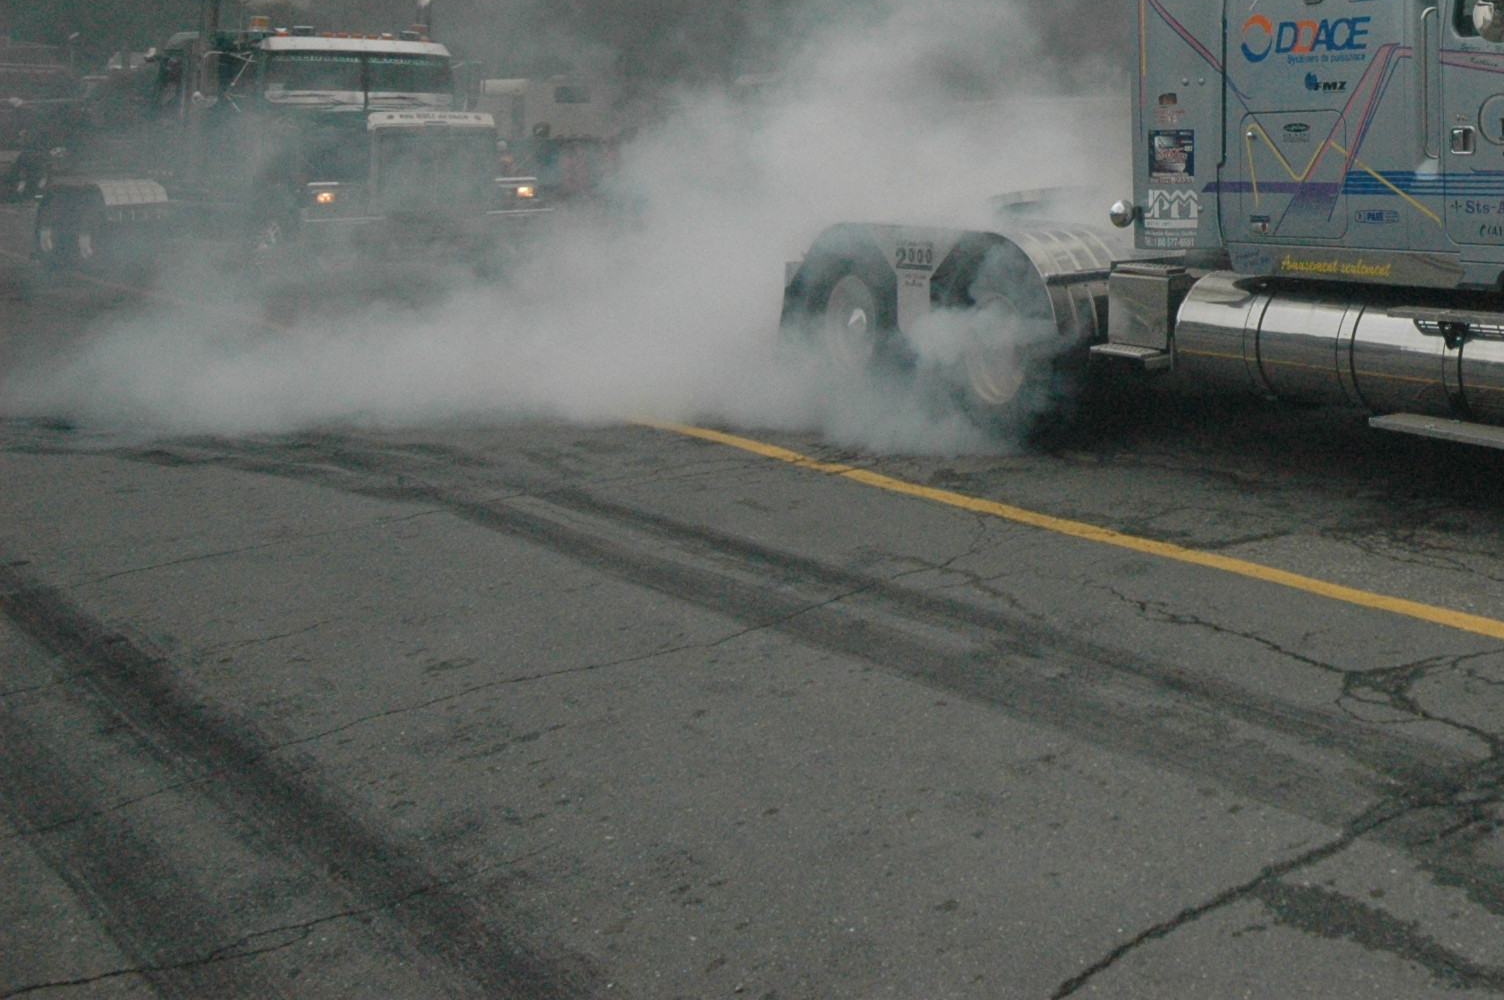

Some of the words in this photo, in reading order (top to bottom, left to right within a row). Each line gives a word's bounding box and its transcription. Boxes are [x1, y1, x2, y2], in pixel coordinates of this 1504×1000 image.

[1313, 81, 1348, 92] FMZ
[896, 247, 933, 270] 2000
[1280, 254, 1338, 274] Amusement
[1340, 258, 1392, 277] seulement
